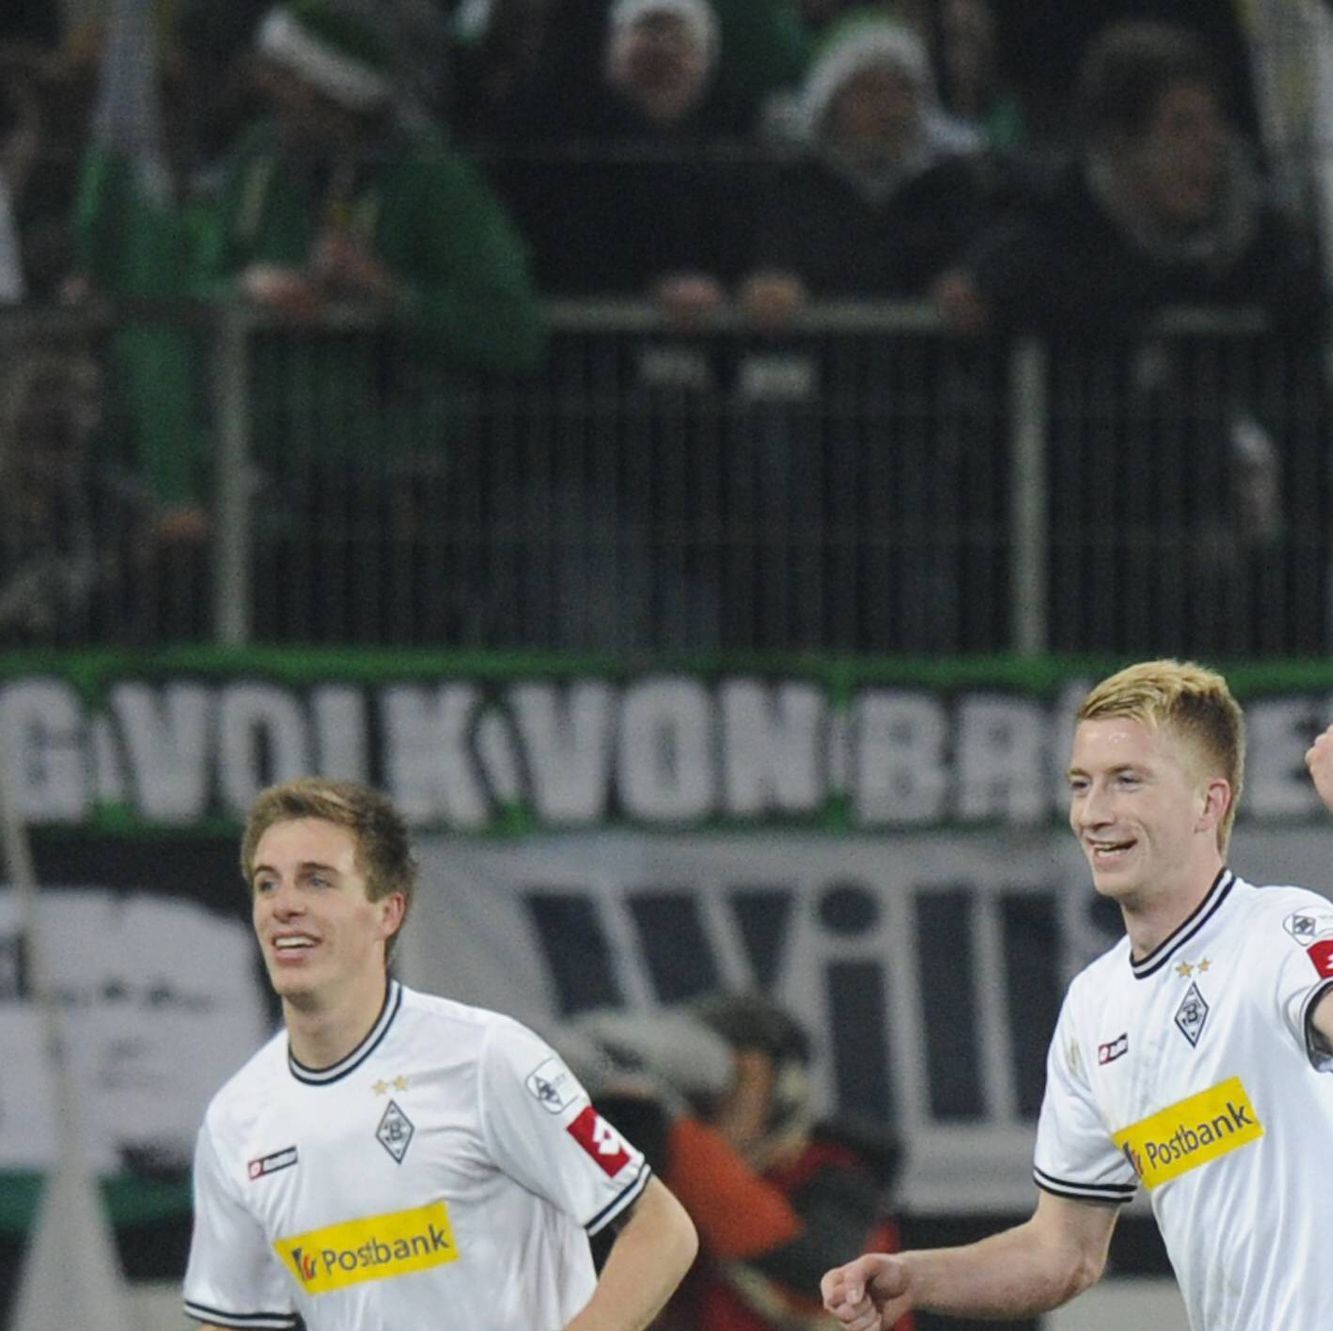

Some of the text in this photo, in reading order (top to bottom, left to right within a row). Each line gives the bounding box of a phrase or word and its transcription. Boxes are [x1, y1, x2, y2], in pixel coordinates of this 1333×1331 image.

[506, 672, 824, 822] VON
[1145, 1101, 1255, 1170] Postbank
[321, 1223, 450, 1276] Postbank
